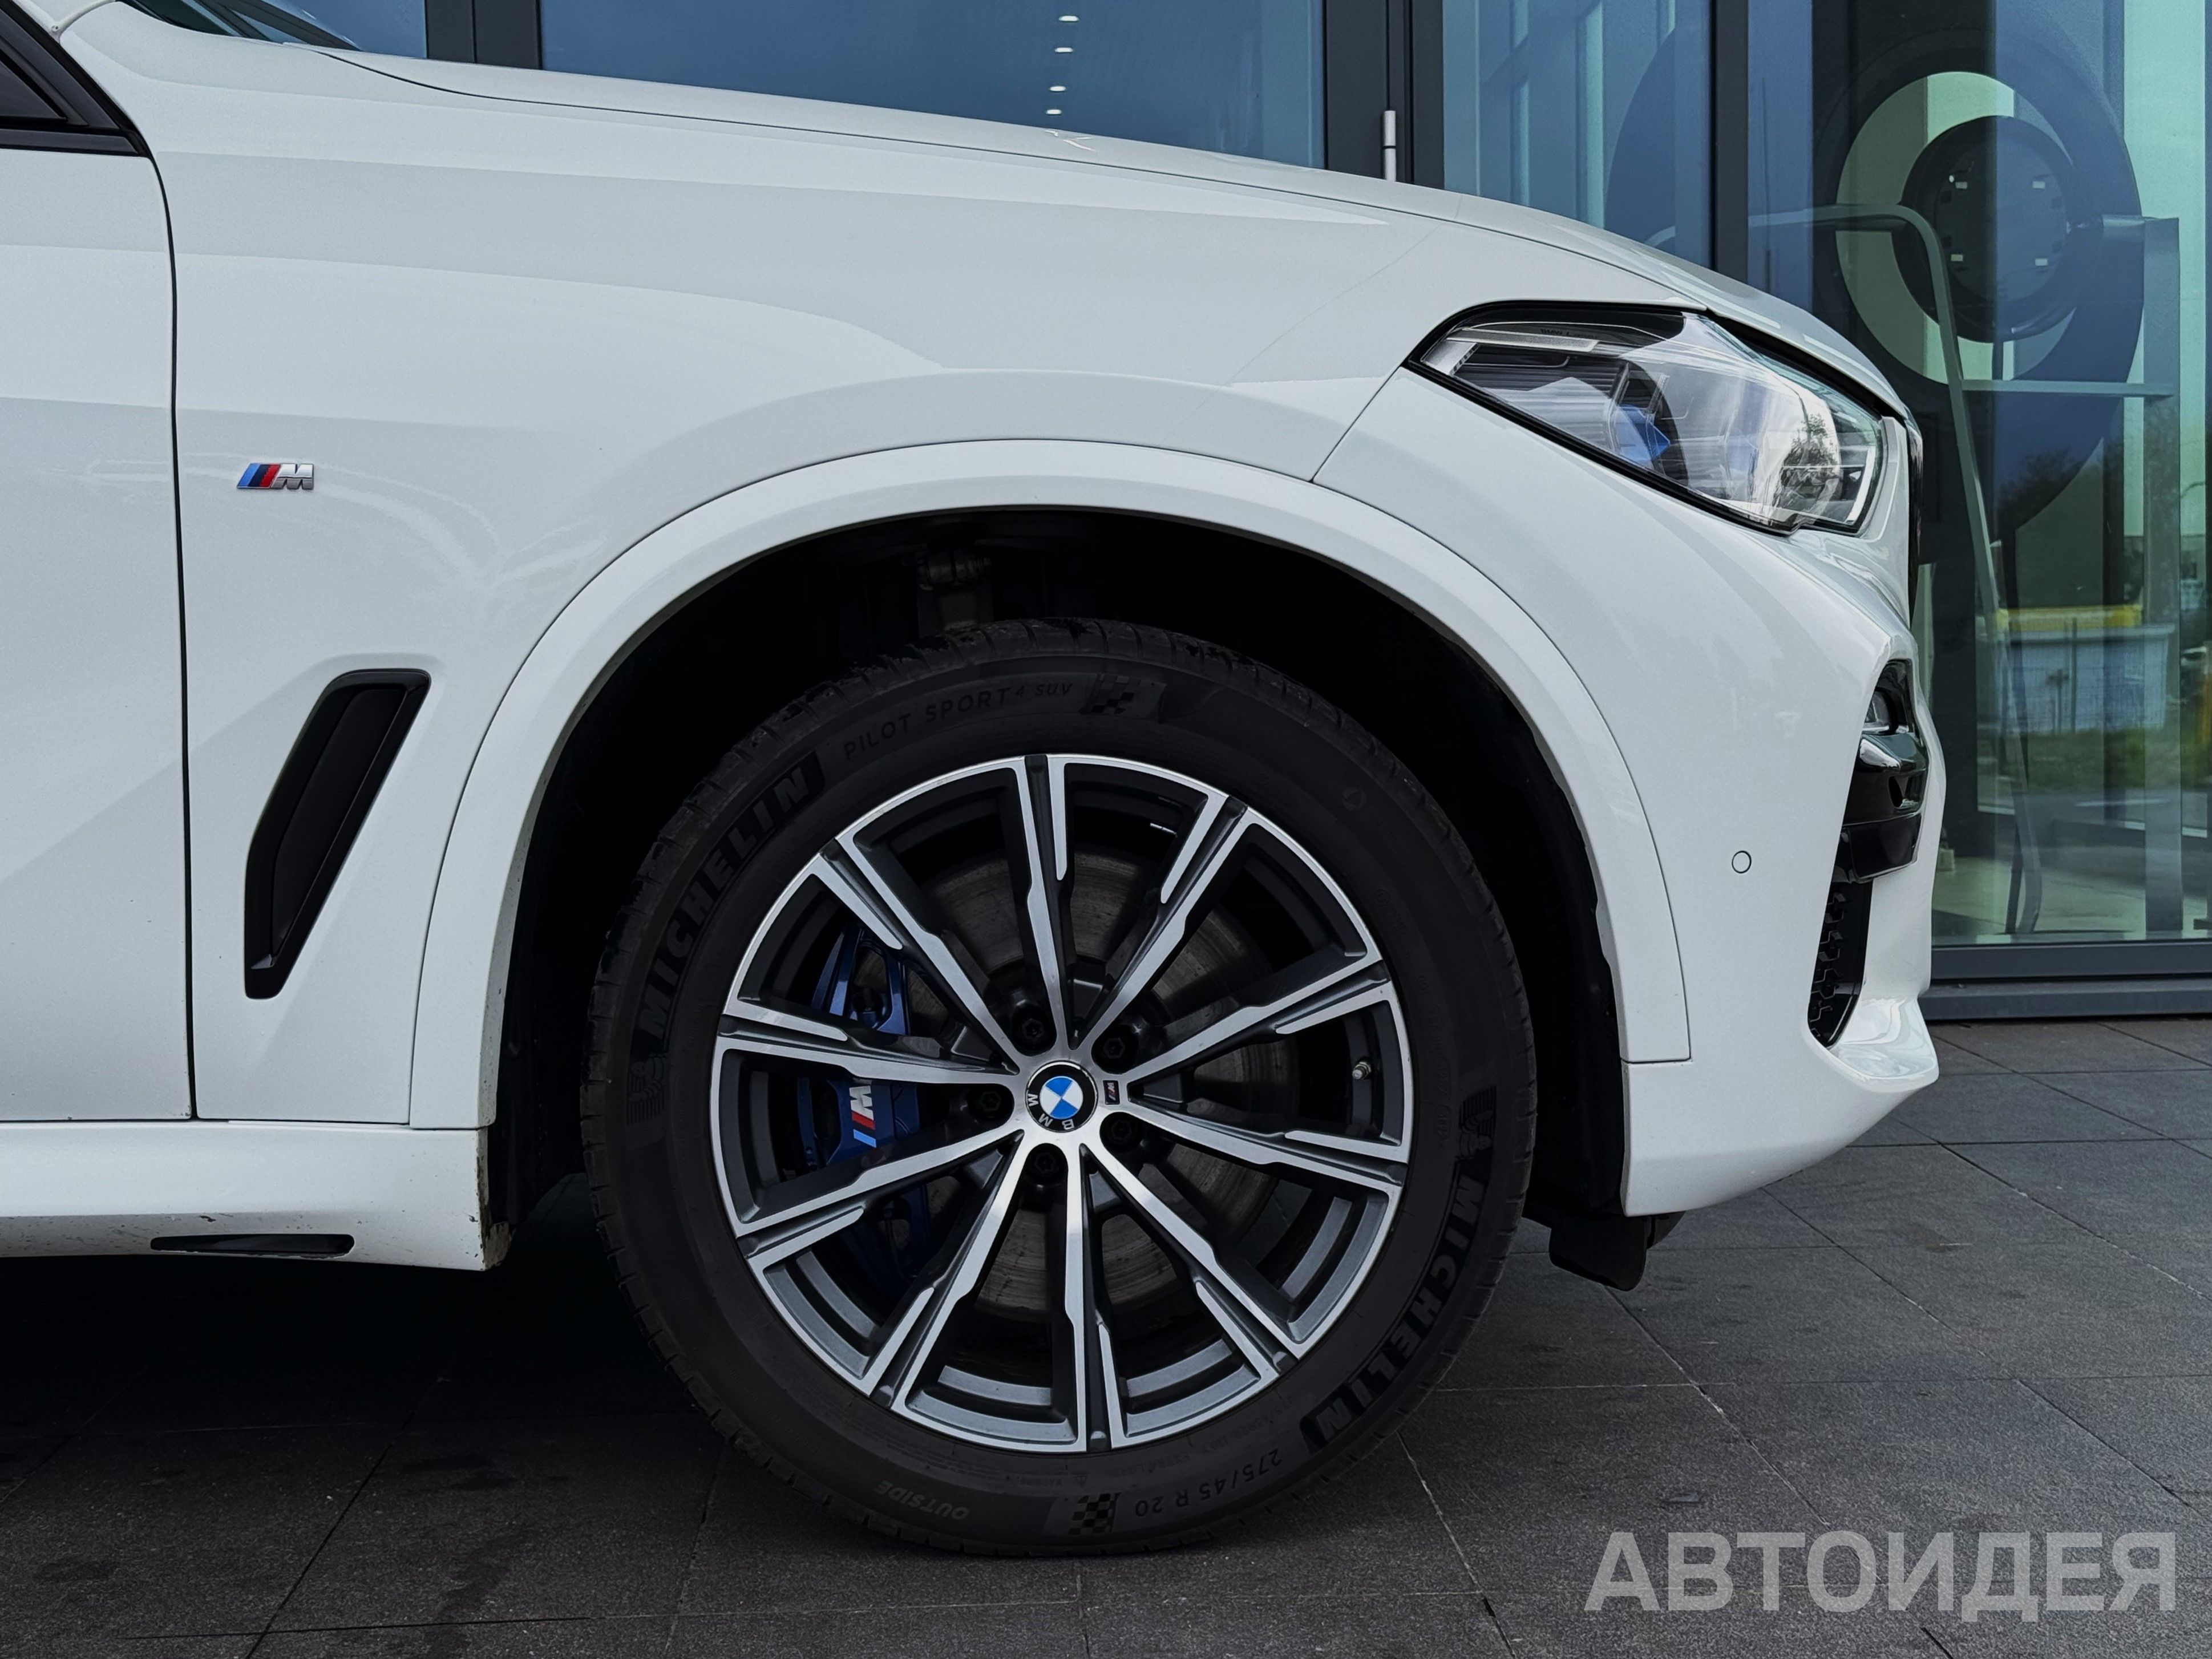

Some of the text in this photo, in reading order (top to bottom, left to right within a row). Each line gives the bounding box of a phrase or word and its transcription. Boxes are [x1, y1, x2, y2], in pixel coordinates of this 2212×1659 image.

[270, 463, 314, 490] M
[844, 714, 912, 760] PILOT
[925, 687, 1012, 723] SPORT
[1034, 683, 1074, 697] SUV
[638, 764, 808, 1040] MICHELIN
[1027, 1092, 1075, 1130] BMW
[1316, 1175, 1485, 1441] MICHELIN
[873, 1480, 970, 1522] OUTSIDE
[1134, 1448, 1283, 1518] 275/45 R 20
